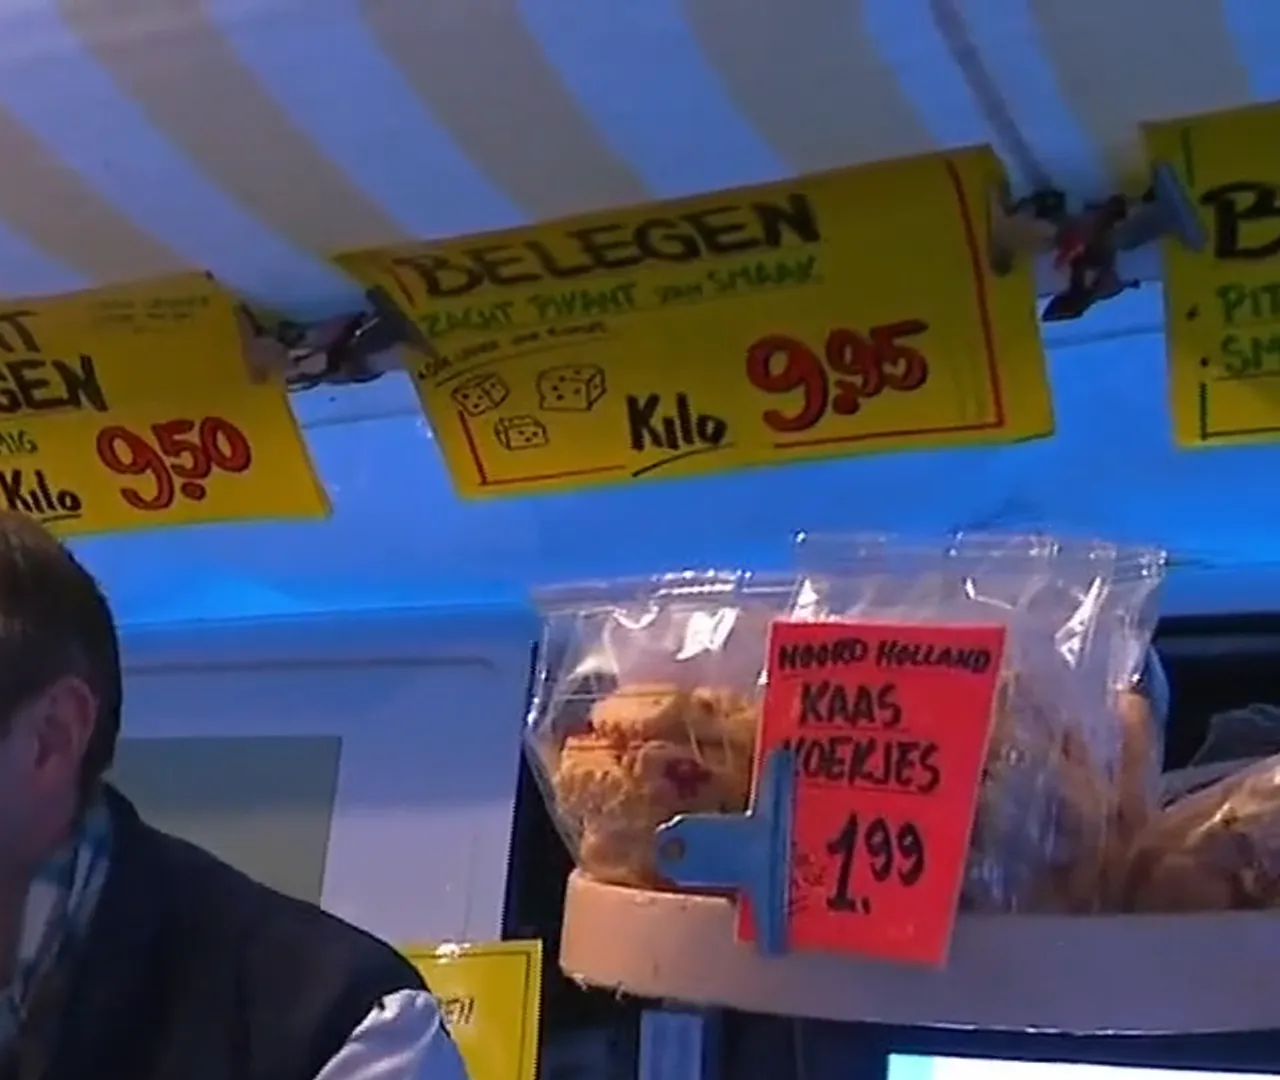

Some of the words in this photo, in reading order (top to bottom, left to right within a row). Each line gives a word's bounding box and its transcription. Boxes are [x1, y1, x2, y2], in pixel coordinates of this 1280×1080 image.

[390, 192, 822, 298] BELEGEN
[420, 300, 514, 338] ZACHT
[528, 281, 638, 318] PIKANT
[707, 255, 817, 292] SMAAK
[626, 392, 729, 454] Kilo
[745, 319, 929, 433] 9.95
[96, 417, 252, 511] 9.50
[778, 637, 869, 671] NOORD
[875, 639, 993, 675] HOLLAND
[799, 680, 902, 727] KAAS
[826, 810, 927, 915] 1.99
